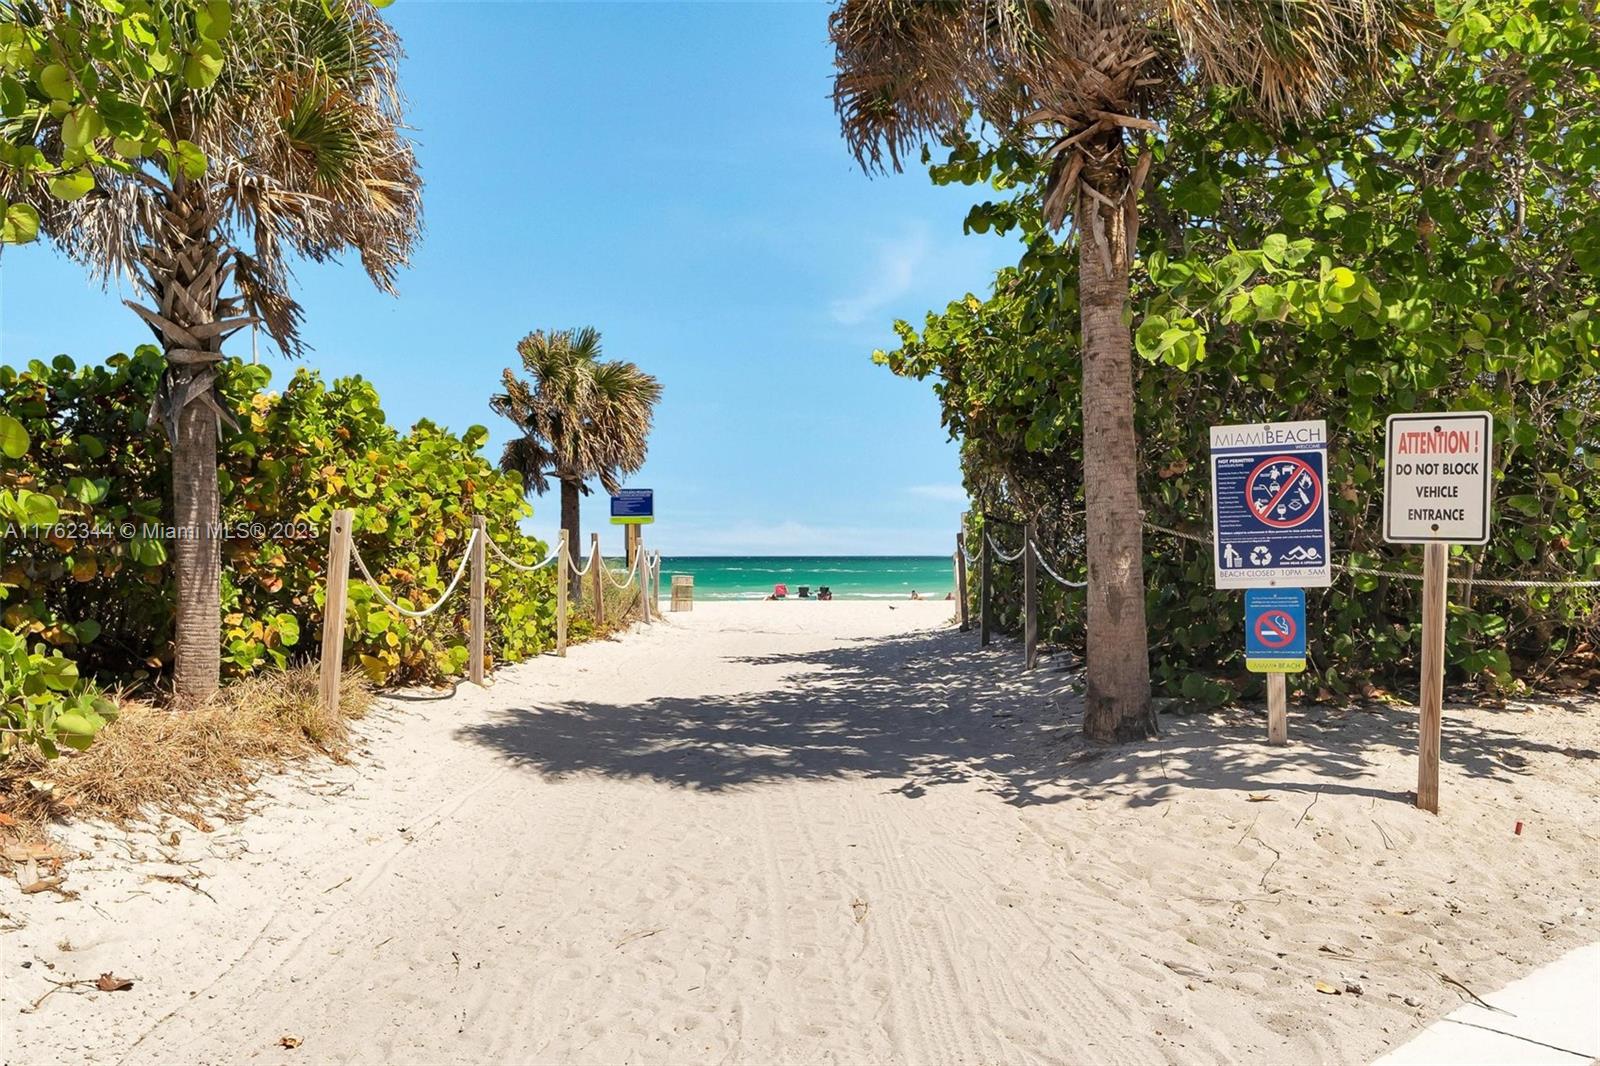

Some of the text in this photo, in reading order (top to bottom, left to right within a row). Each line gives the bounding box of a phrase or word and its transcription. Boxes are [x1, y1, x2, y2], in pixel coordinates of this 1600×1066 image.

[1397, 430, 1479, 454] ATTENTION !
[1396, 462, 1479, 475] DO NOT BLOCK
[1415, 486, 1459, 498] VEHICLE
[1408, 508, 1465, 521] ENTRANCE
[1220, 570, 1244, 578] BEACH
